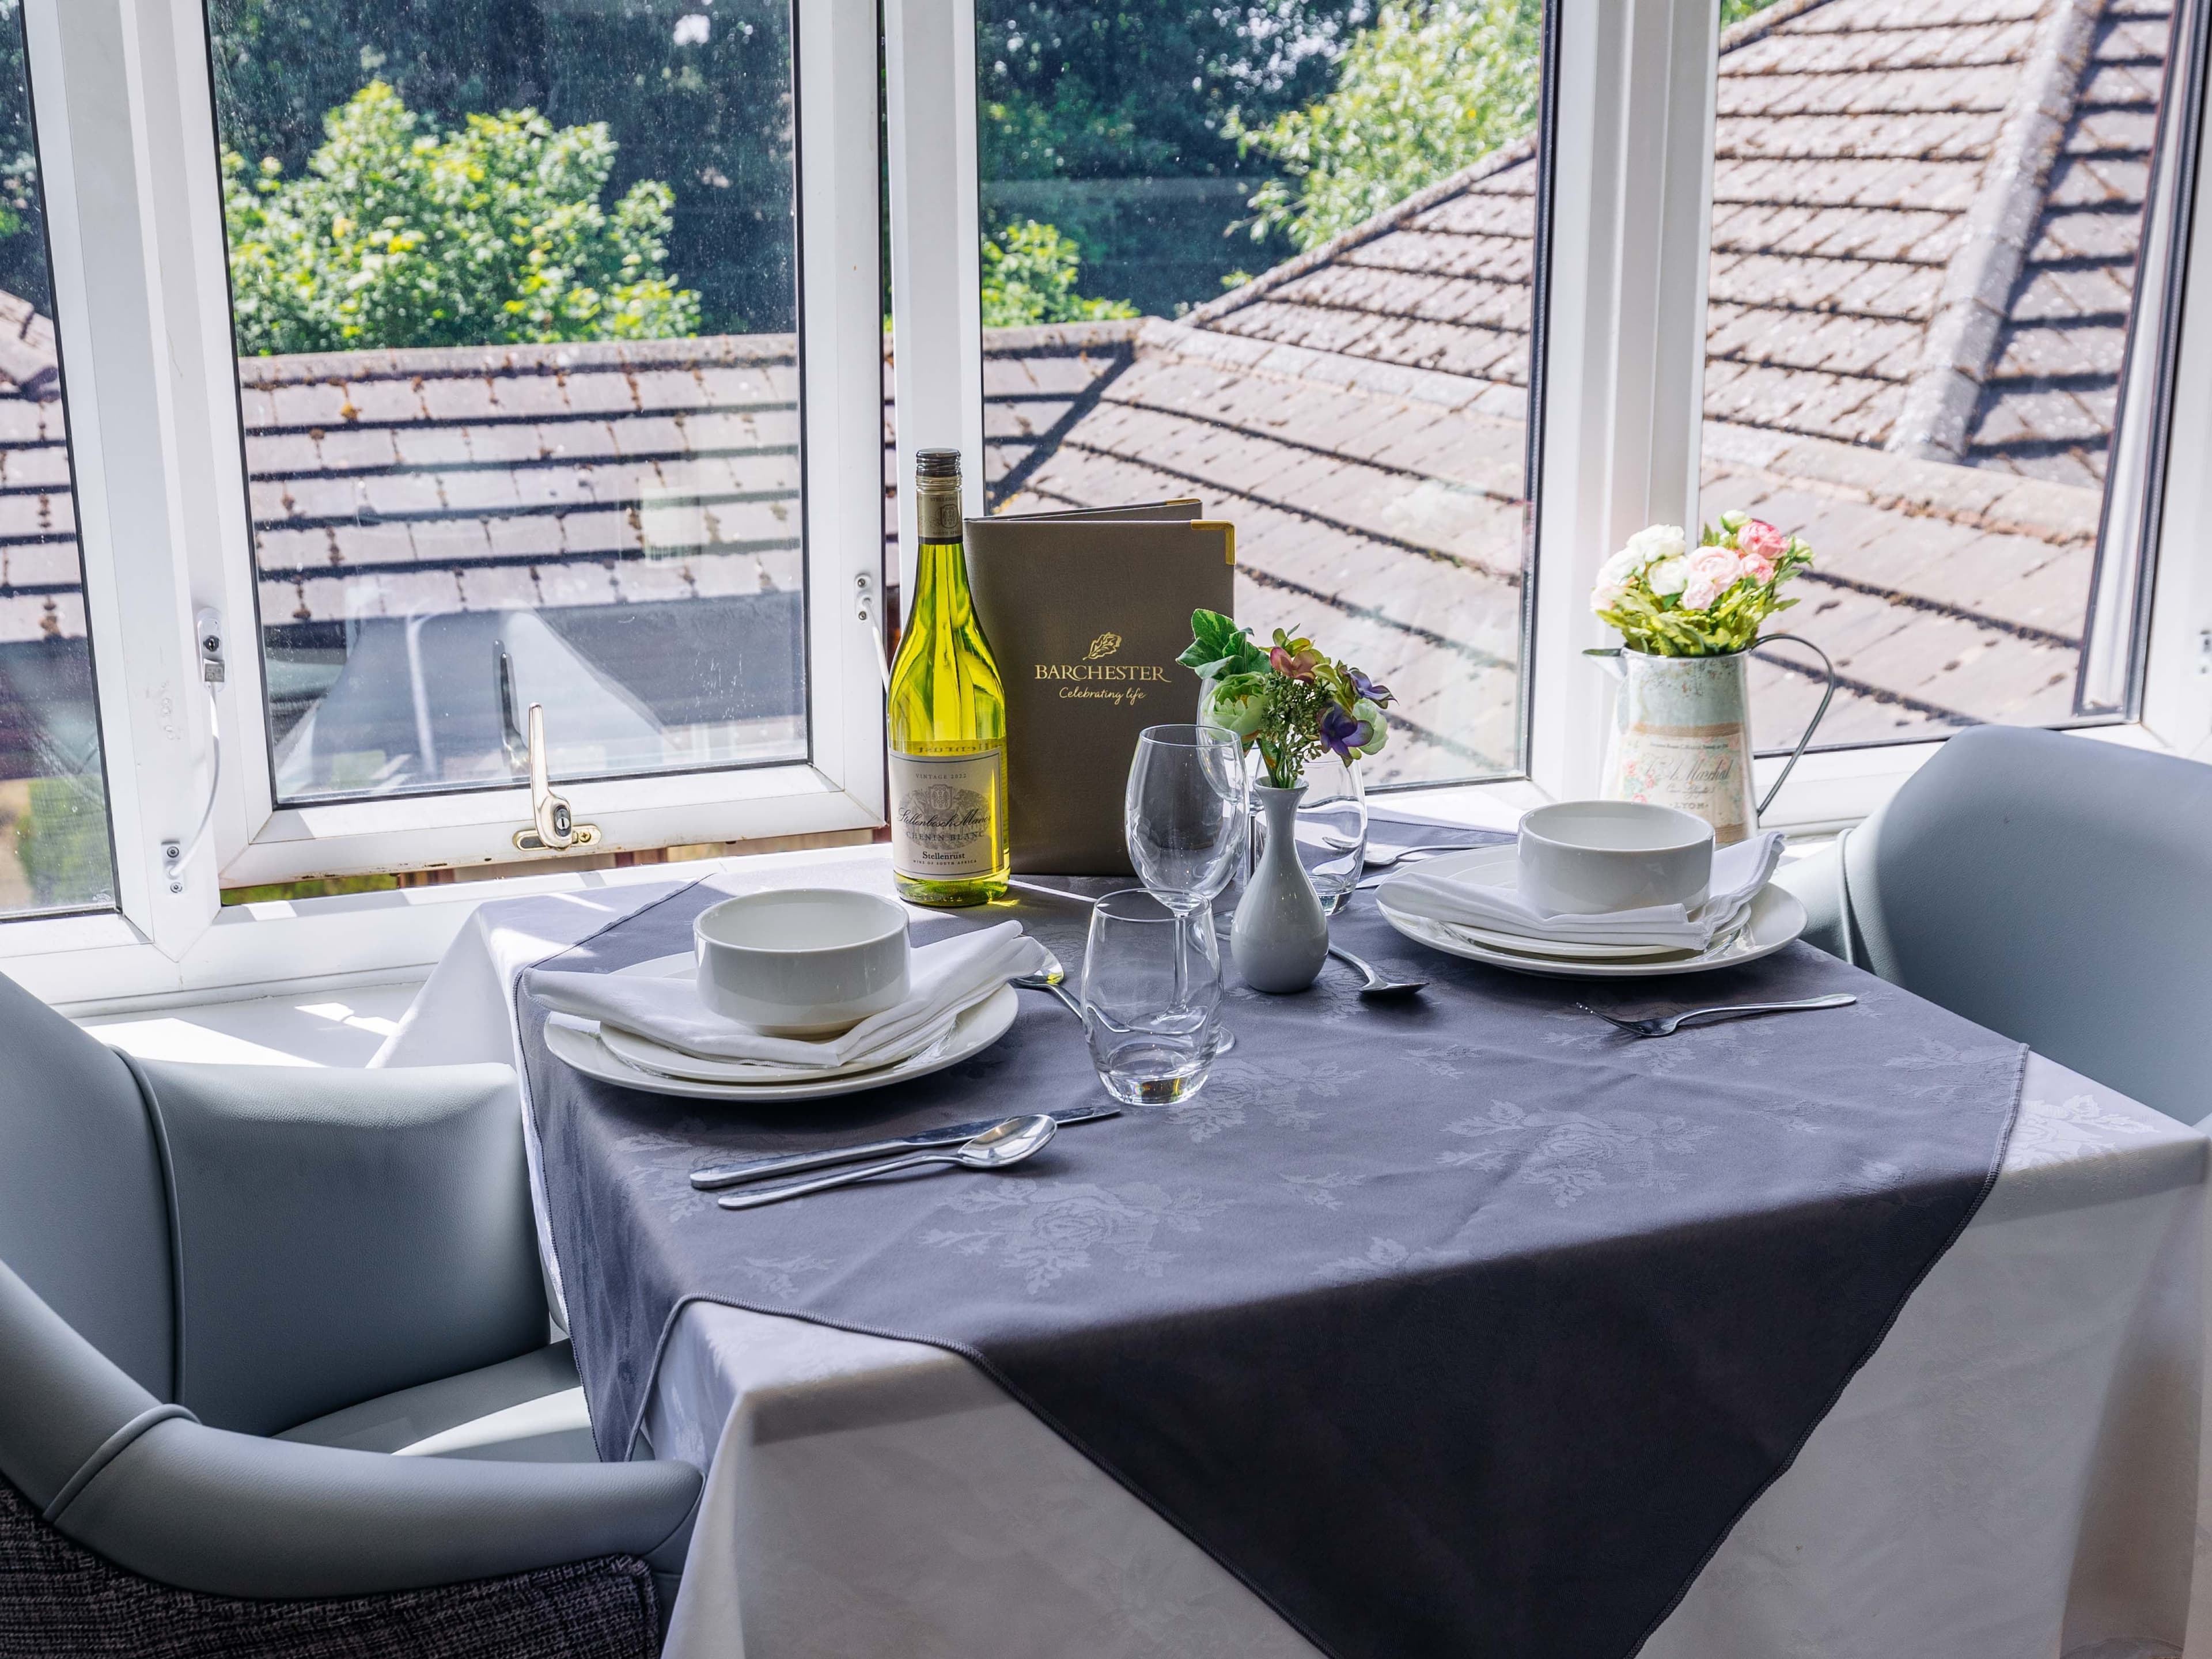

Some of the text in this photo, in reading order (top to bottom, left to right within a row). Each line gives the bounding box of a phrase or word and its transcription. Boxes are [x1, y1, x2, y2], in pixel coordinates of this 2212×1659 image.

[1035, 664, 1172, 683] BARCHESTER
[1059, 686, 1146, 706] Celebrating life
[897, 807, 957, 827] Stellenbosch
[906, 830, 986, 842] CHENIN BLANC
[922, 851, 965, 859] Stellenrust
